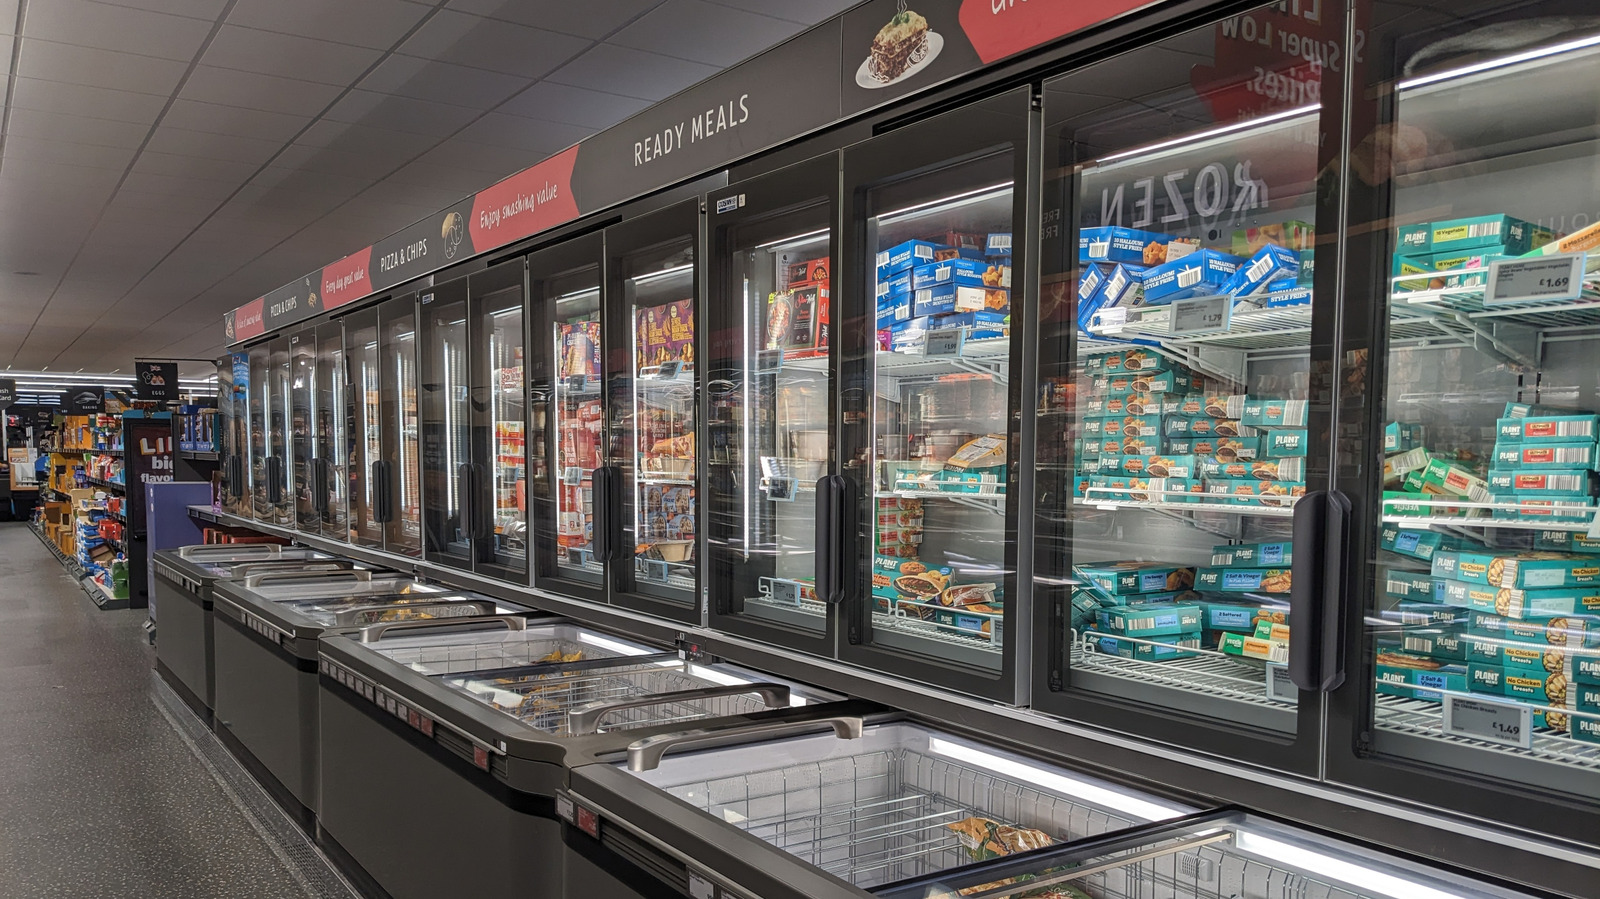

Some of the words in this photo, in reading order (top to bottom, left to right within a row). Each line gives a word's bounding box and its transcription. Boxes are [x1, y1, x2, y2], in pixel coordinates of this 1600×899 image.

[634, 122, 684, 167] READY
[691, 94, 749, 144] MEALS
[480, 205, 501, 230] Enjoy
[502, 193, 535, 219] smashing
[537, 180, 558, 205] value
[1405, 231, 1427, 243] PLANT
[1120, 238, 1144, 247] HALLOUMI
[380, 252, 399, 273] PIZZA
[400, 248, 405, 265] &
[407, 238, 427, 262] CHIPS
[354, 266, 364, 282] value
[1149, 270, 1175, 282] HALLOUMI
[1144, 282, 1159, 291] STYLE
[1160, 276, 1175, 285] FRIES
[1271, 295, 1289, 303] STYLE
[1290, 292, 1308, 300] FRIES
[270, 302, 281, 318] PIZZA
[285, 295, 297, 312] CHIPS
[1085, 422, 1100, 430] PLANT
[1172, 421, 1188, 429] PLANT
[1502, 426, 1521, 434] PLANT
[1275, 436, 1300, 445] PLANT
[1085, 442, 1099, 450] PLANT
[1102, 458, 1120, 467] PLANT
[1210, 485, 1228, 493] PLANT
[1383, 529, 1397, 539] PLANT
[1542, 531, 1567, 540] PLANT
[1236, 549, 1253, 558] PLANT
[875, 557, 898, 567] PLANT
[1437, 557, 1456, 568] PLANT
[1122, 577, 1135, 586] PLANT
[1412, 580, 1430, 590] PLANT
[1448, 585, 1465, 595] PLANT
[1433, 611, 1455, 620] PLANT
[1476, 616, 1501, 626] PLANT
[1514, 629, 1535, 637] Breasts
[1436, 637, 1458, 647] PLANT
[1474, 642, 1498, 653] PLANT
[1511, 656, 1532, 664] Breasts
[1383, 672, 1405, 683] PLANT
[1474, 670, 1499, 680] PLANT
[1421, 681, 1442, 689] Vinegar
[1517, 679, 1540, 687] Chicken
[1513, 685, 1534, 693] Breasts
